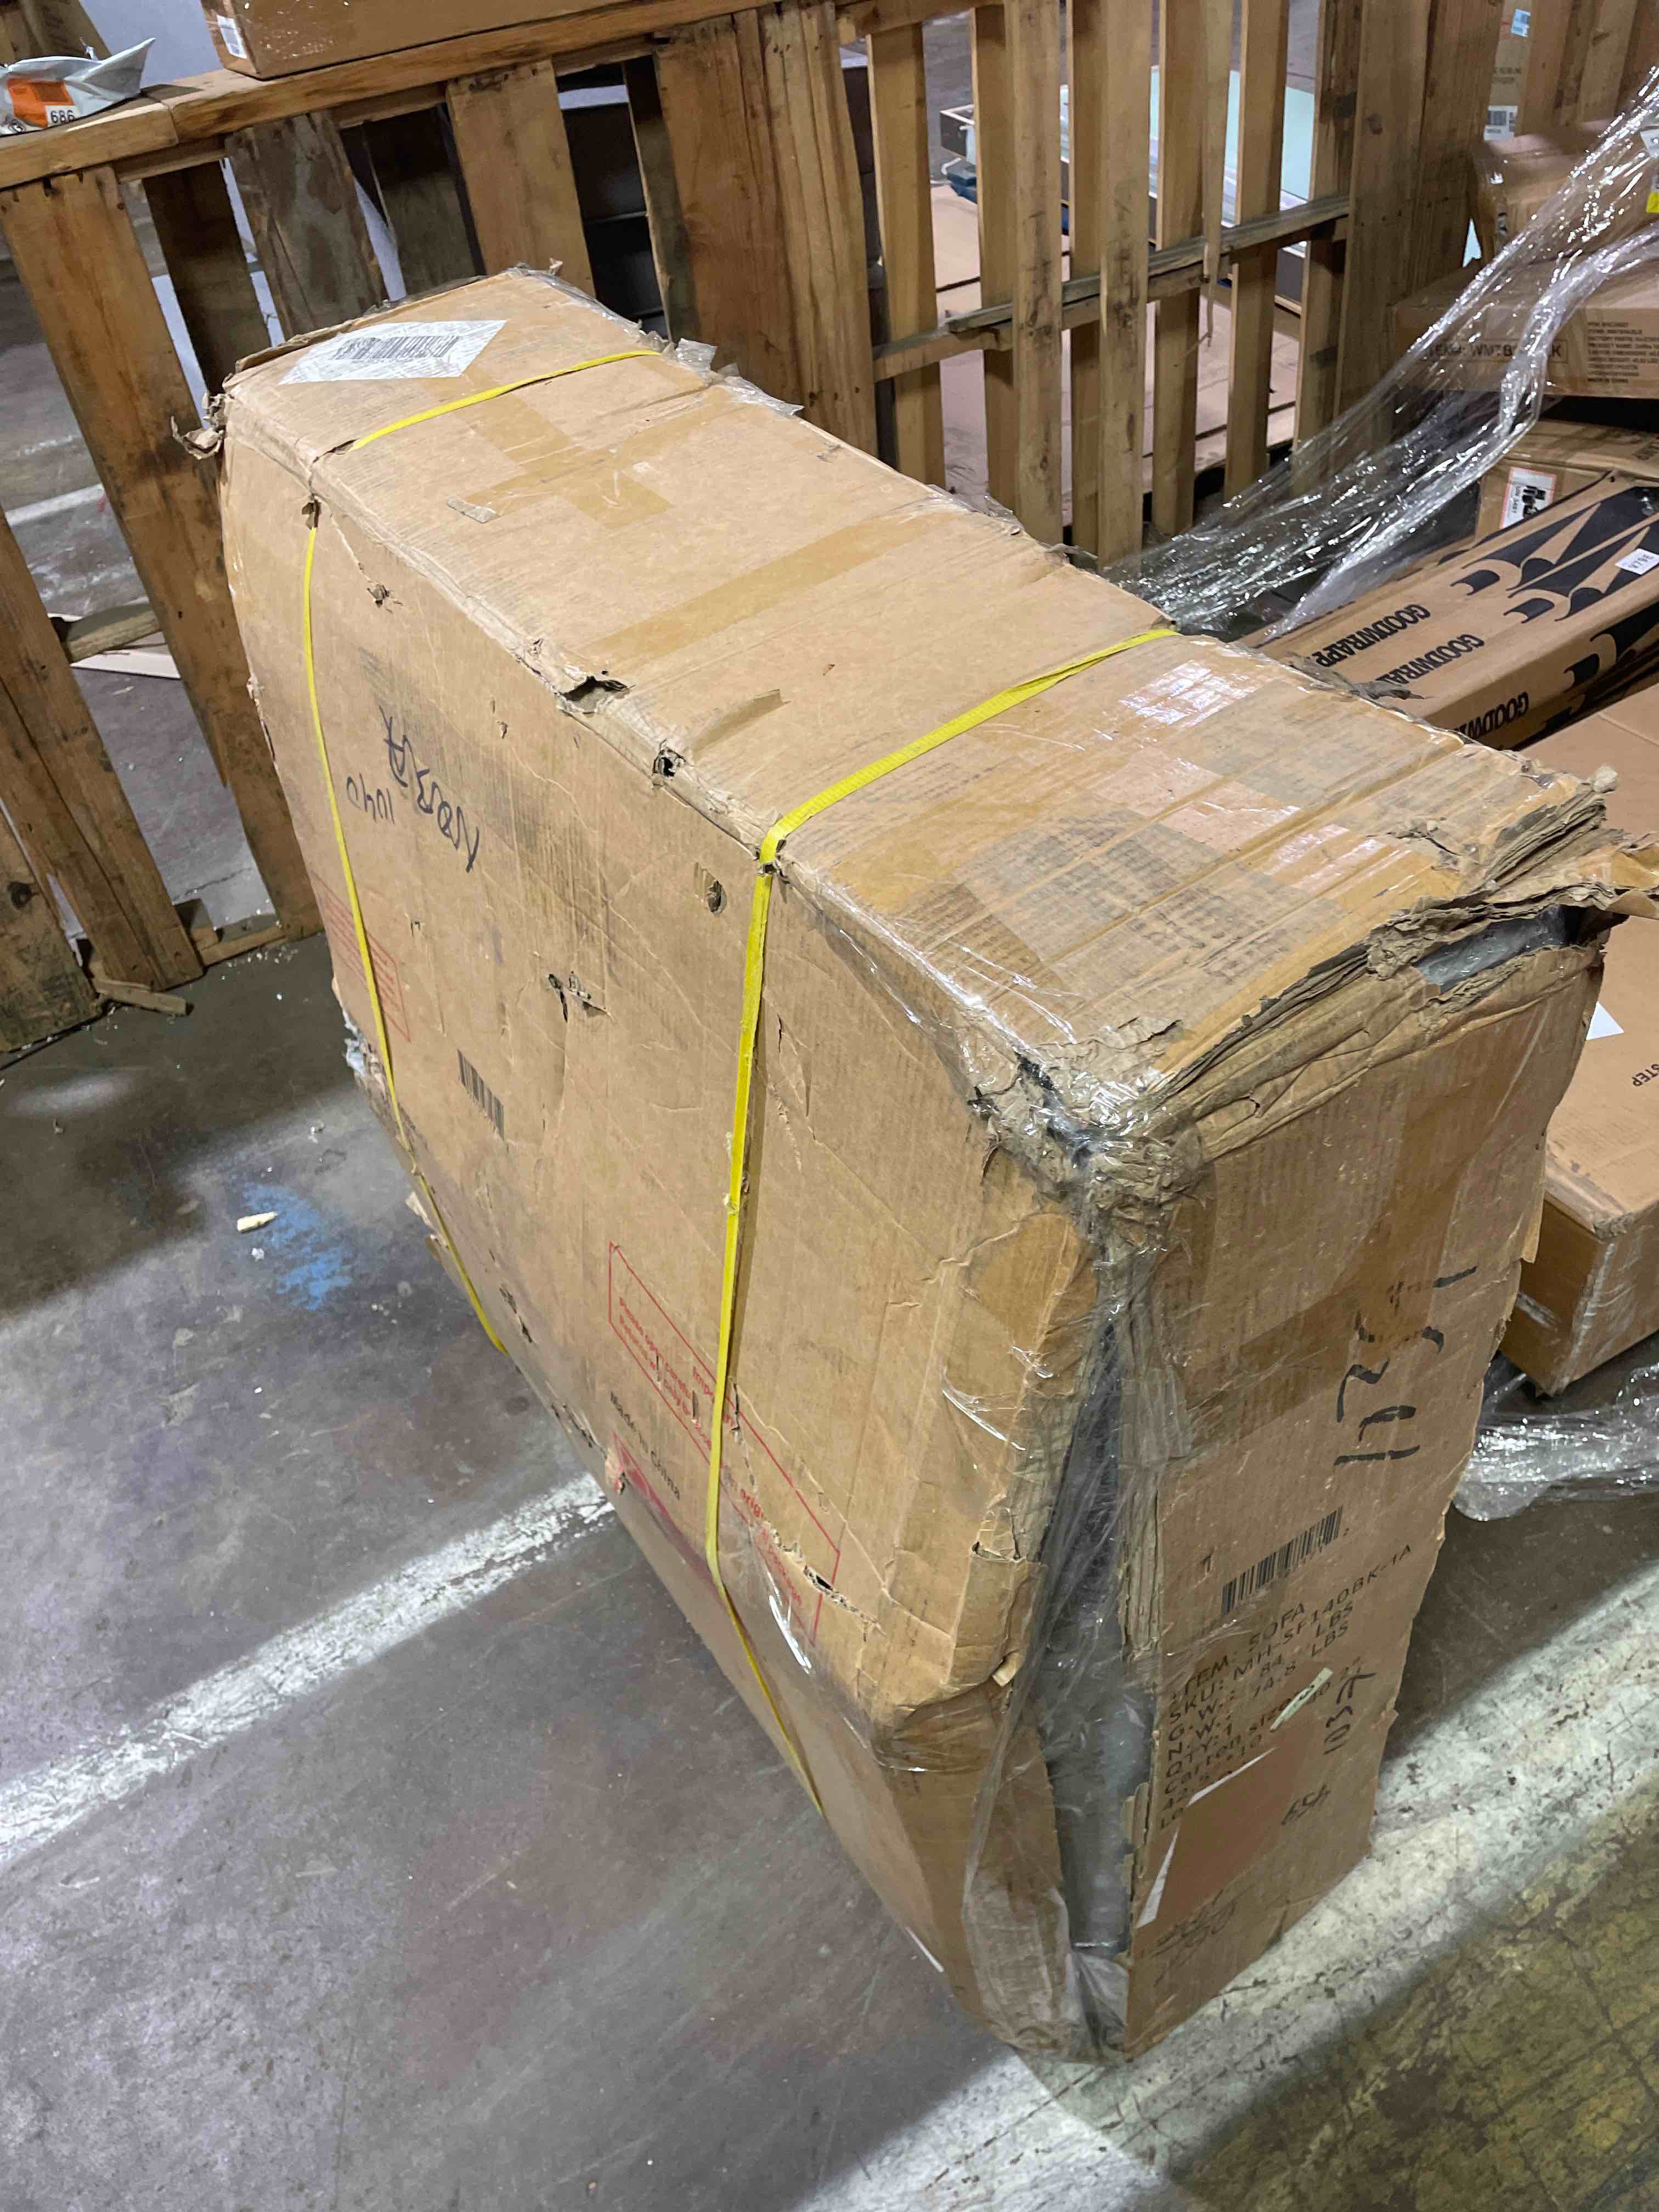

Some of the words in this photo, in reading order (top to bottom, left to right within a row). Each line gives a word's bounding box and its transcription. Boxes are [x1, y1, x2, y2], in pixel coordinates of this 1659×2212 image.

[1308, 603, 1431, 667] GOODWRAPP
[1248, 1602, 1305, 1652] SOFA
[1311, 1621, 1349, 1657] LBS
[1316, 1601, 1353, 1639] LBS
[1170, 1678, 1224, 1725] SKU:
